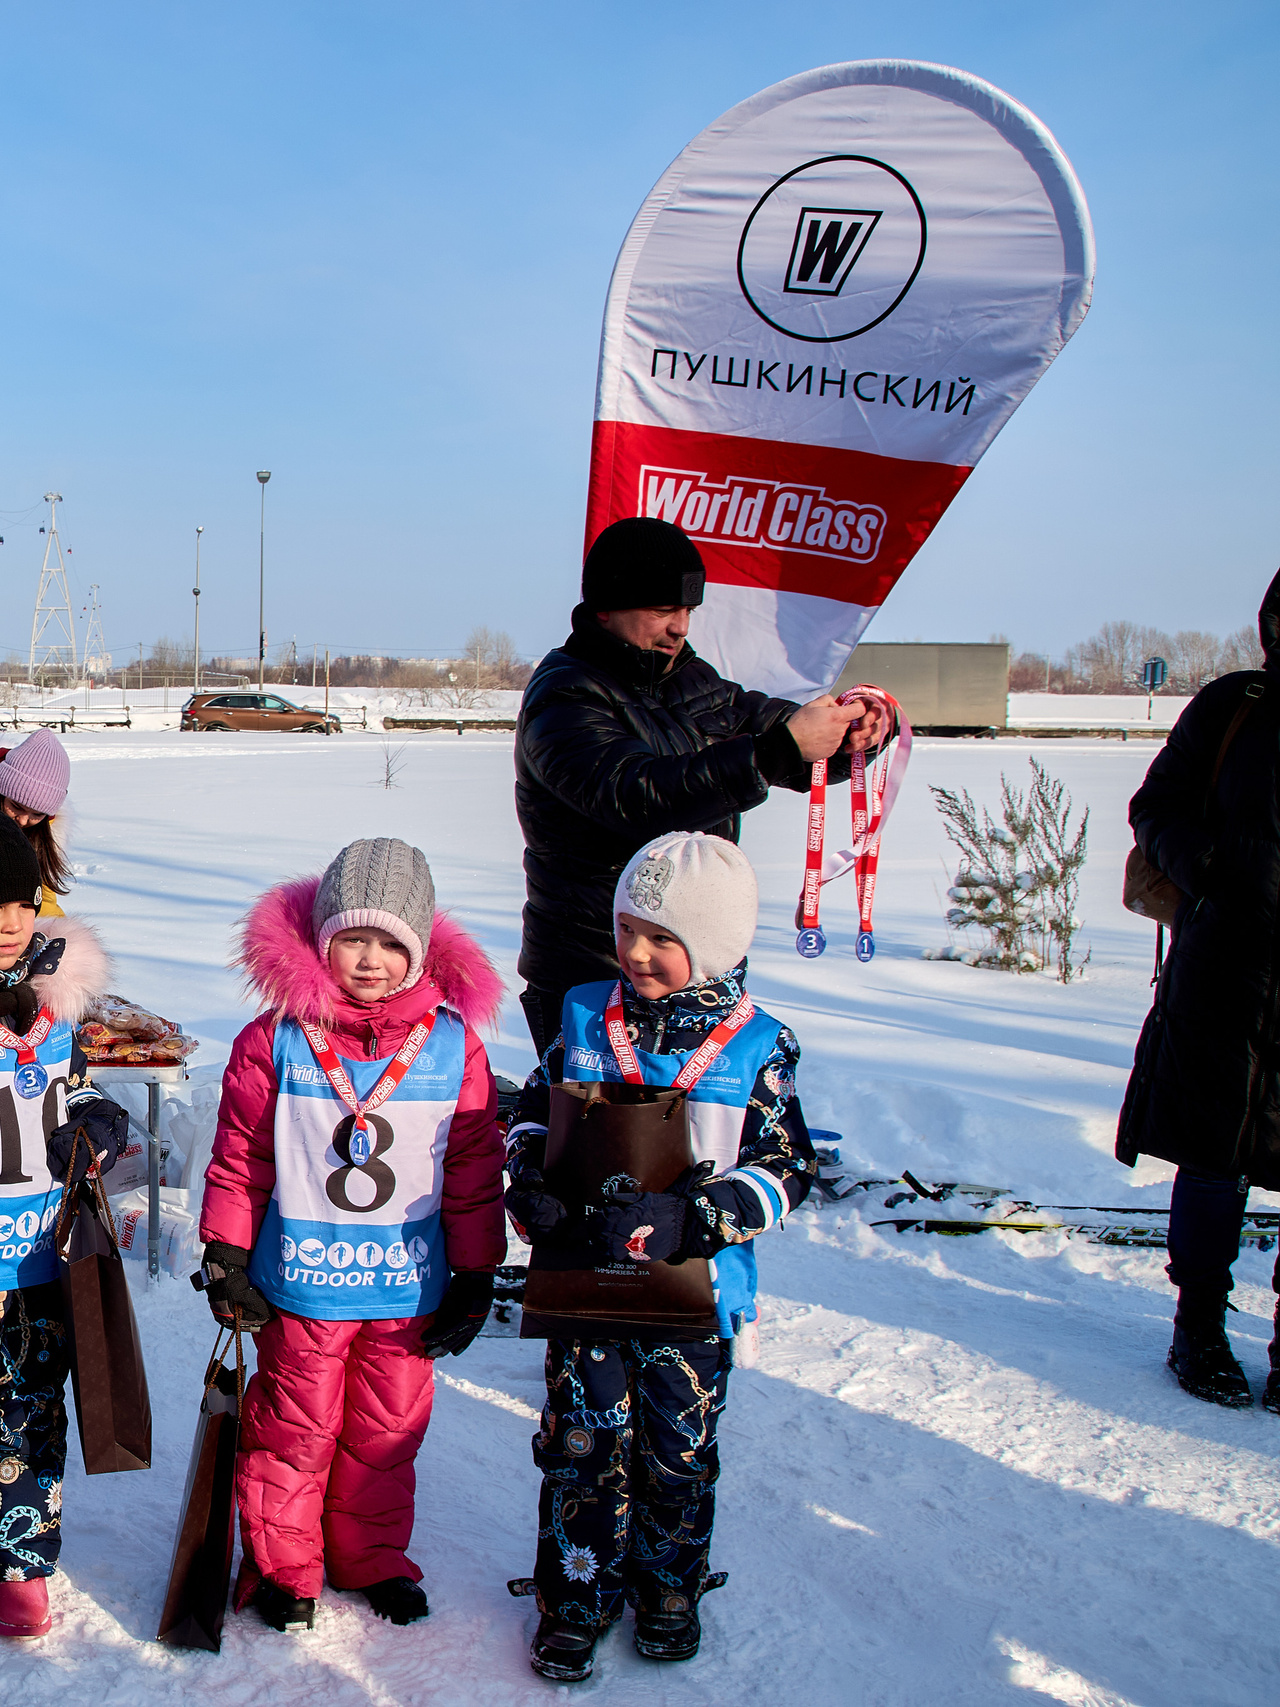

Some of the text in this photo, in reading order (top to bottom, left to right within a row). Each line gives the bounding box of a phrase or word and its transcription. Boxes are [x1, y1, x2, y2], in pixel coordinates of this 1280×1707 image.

[796, 219, 864, 284] W
[650, 348, 976, 416] ПУШКИНСКИЙ
[646, 475, 879, 555] World Class
[853, 767, 864, 792] World
[809, 804, 822, 851] World Class
[805, 870, 821, 916] World Class
[806, 934, 817, 949] 3
[862, 938, 868, 953] 1
[397, 1023, 429, 1065] World Class
[570, 1047, 598, 1068] World
[609, 1021, 637, 1074] World Class
[24, 1070, 37, 1087] 3
[679, 1040, 719, 1087] World Class
[329, 1067, 352, 1094] World
[374, 1076, 396, 1099] Class
[357, 1136, 363, 1154] 1
[325, 1112, 396, 1213] 8
[120, 1219, 136, 1249] World
[278, 1261, 431, 1287] OUTDOOR TEAM
